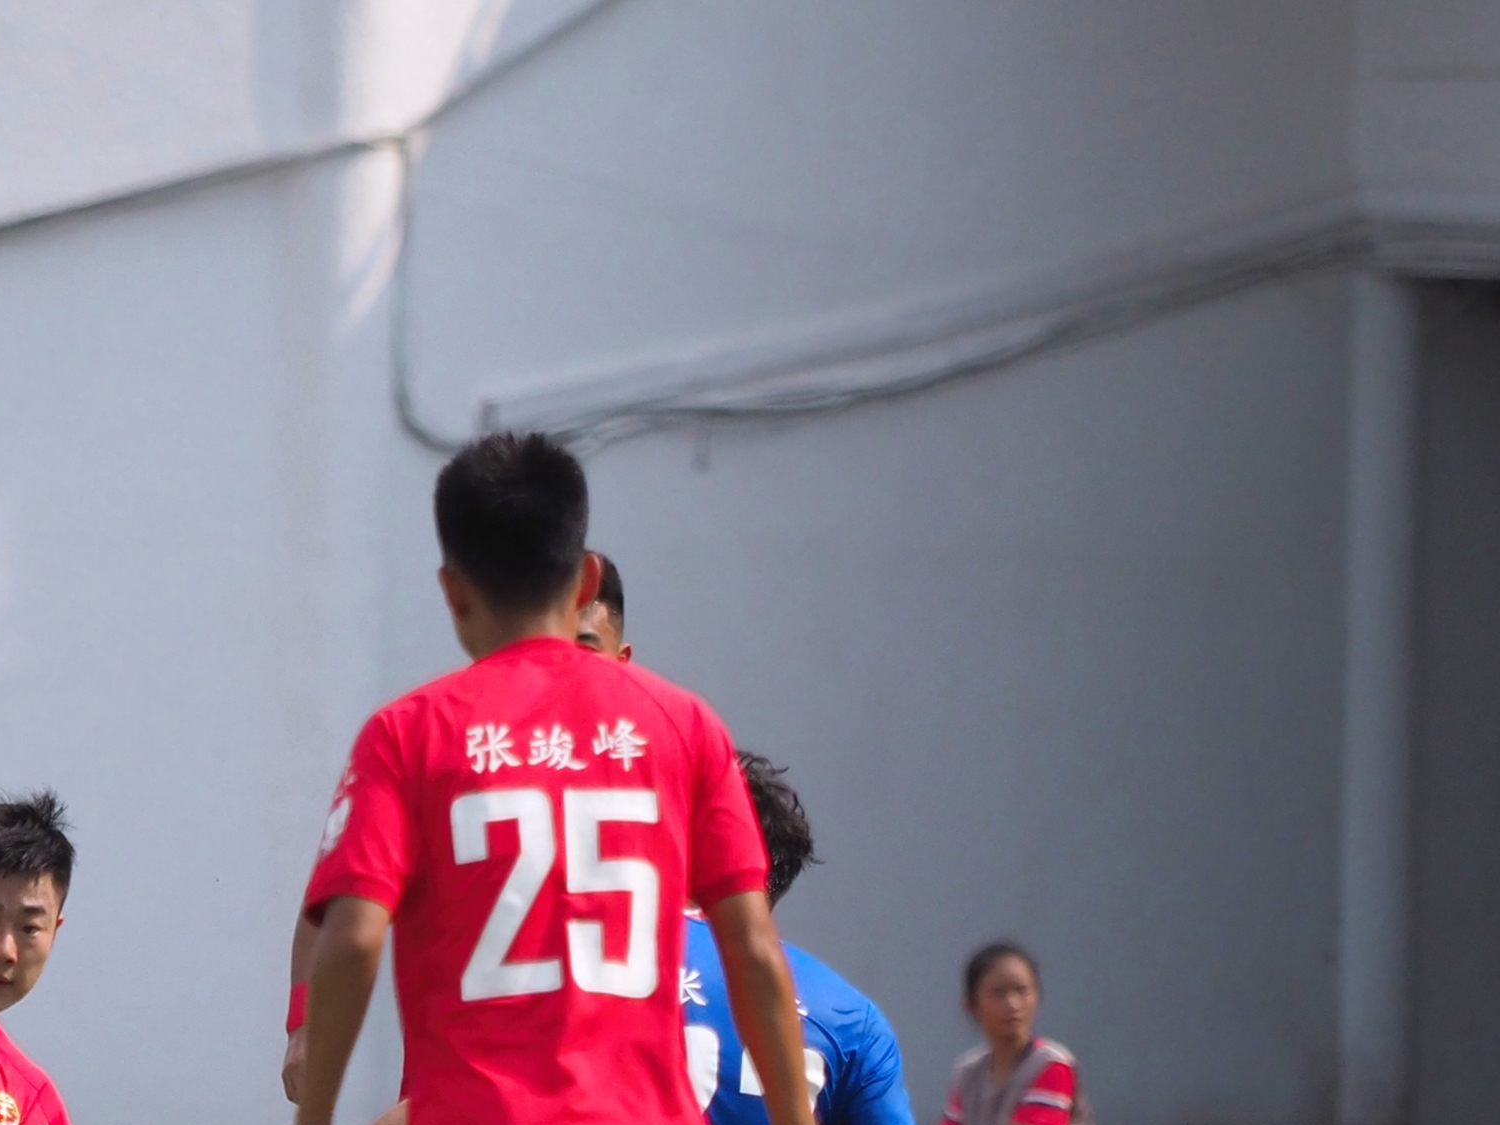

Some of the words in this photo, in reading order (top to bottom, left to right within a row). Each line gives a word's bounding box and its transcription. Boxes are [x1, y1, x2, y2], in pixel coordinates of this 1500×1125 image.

[466, 717, 648, 774] 张竣峰
[450, 787, 659, 1002] 25
